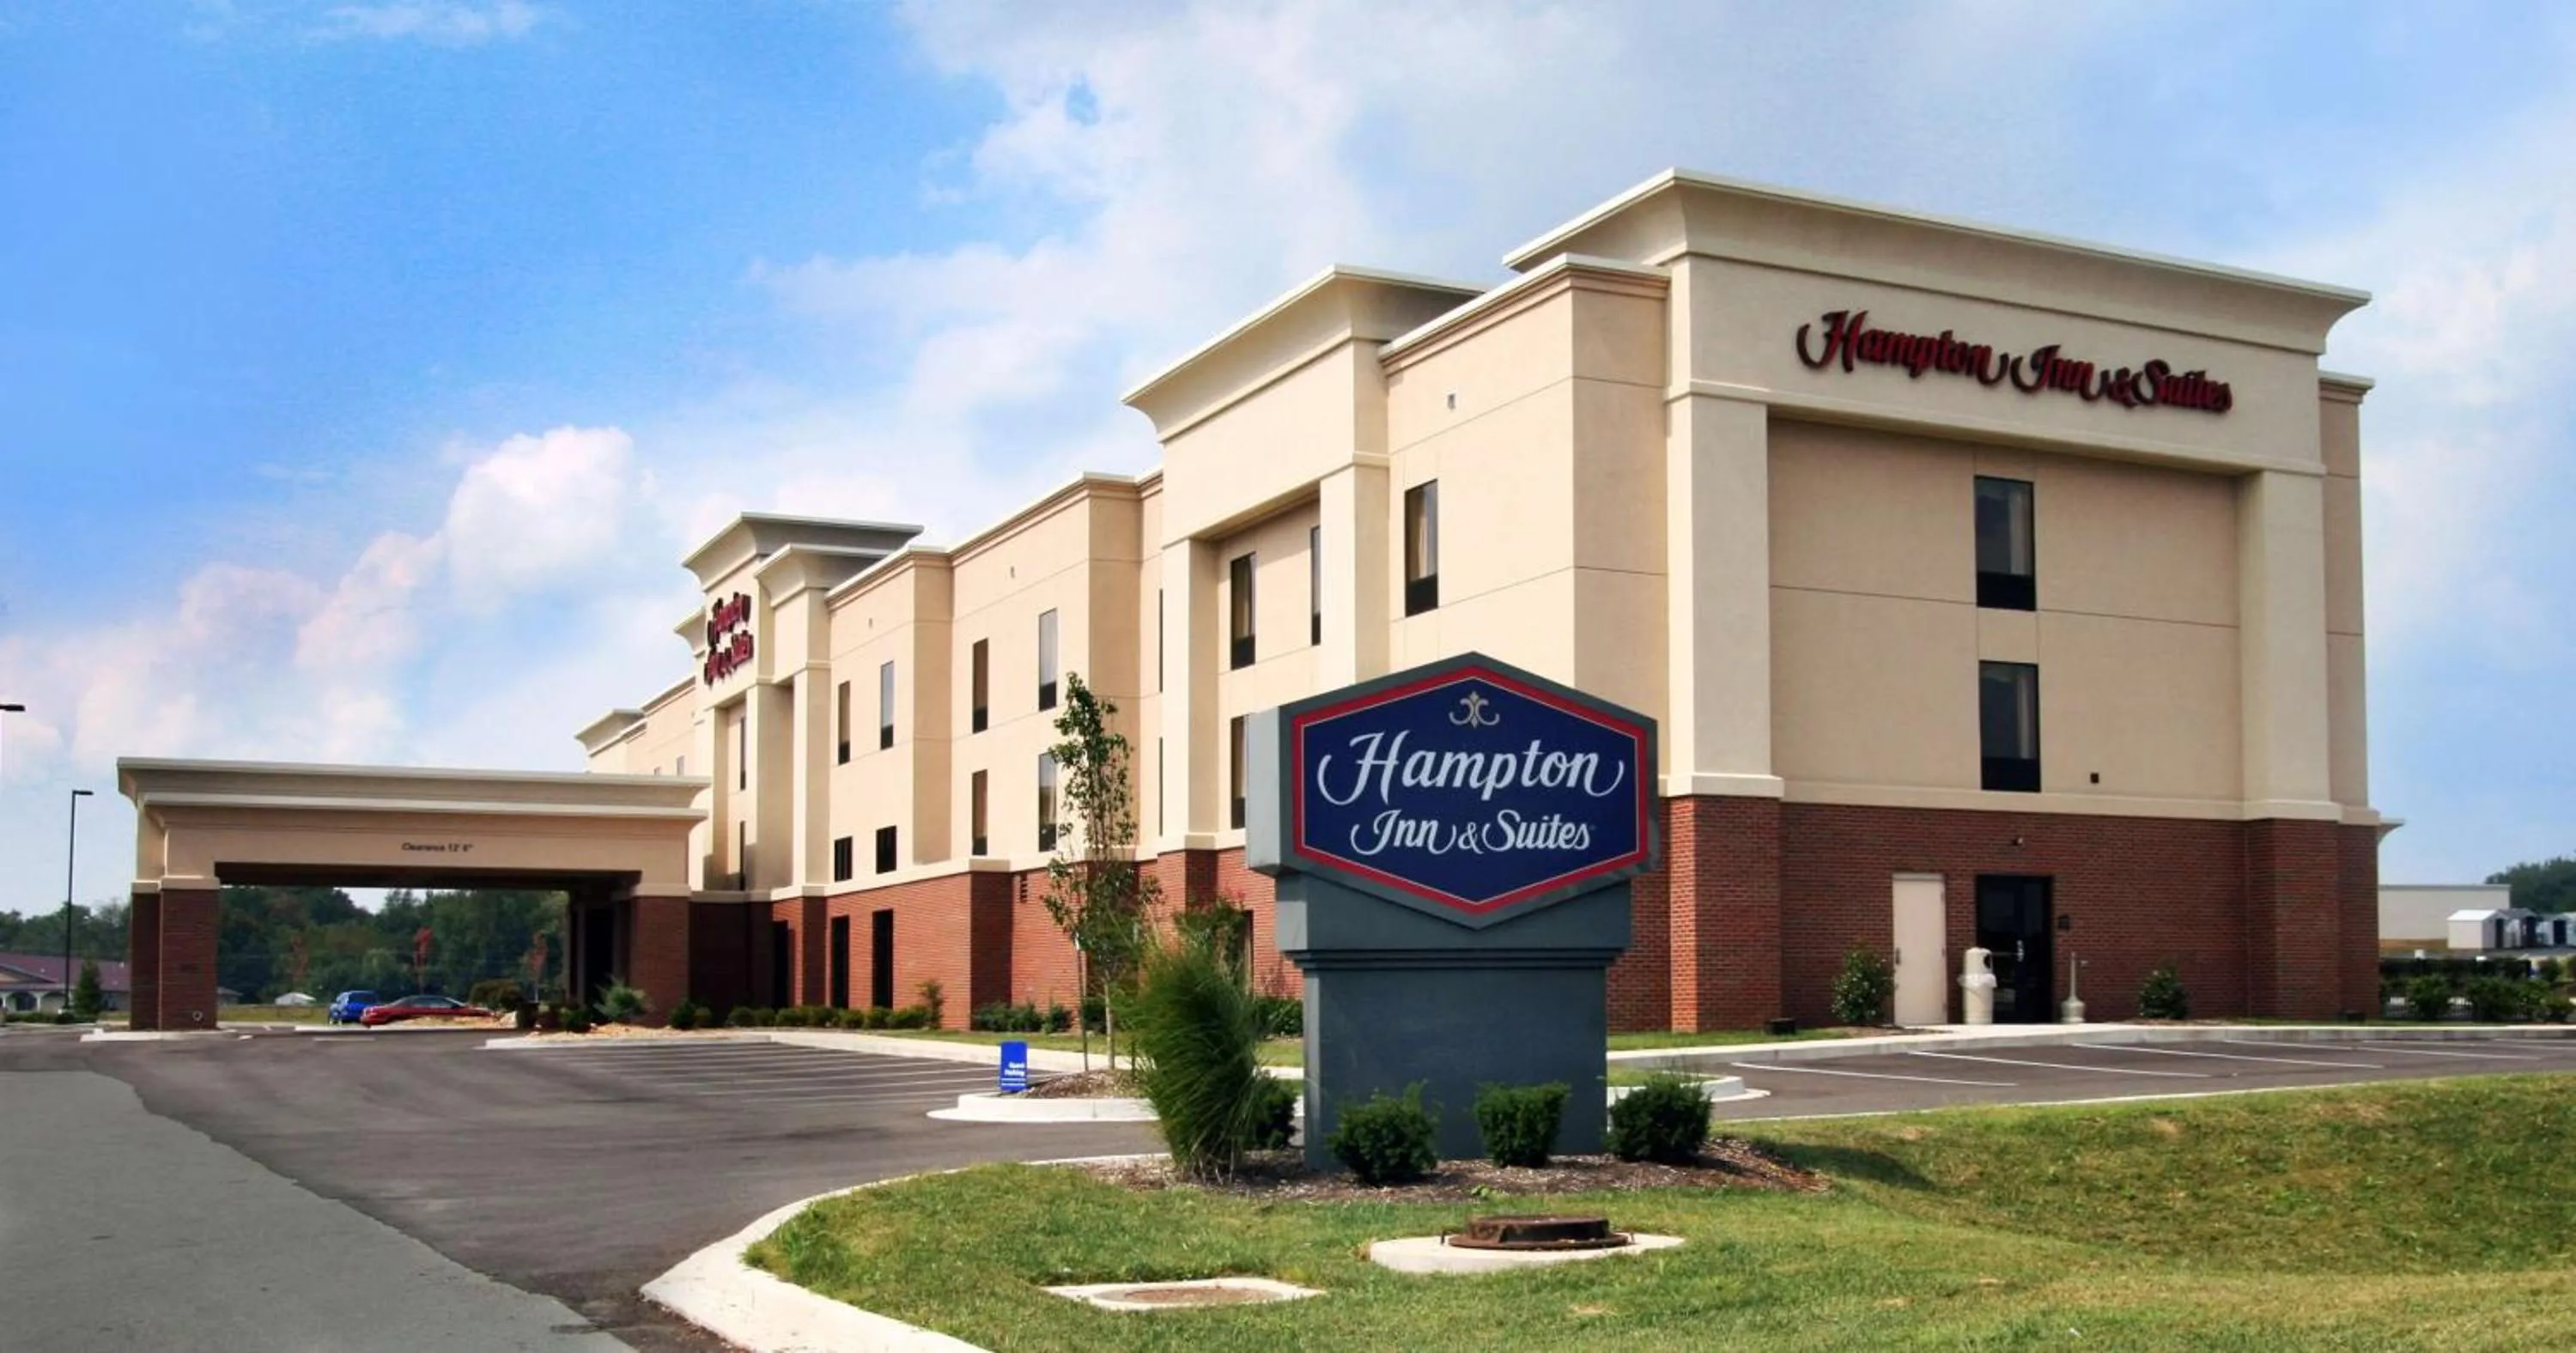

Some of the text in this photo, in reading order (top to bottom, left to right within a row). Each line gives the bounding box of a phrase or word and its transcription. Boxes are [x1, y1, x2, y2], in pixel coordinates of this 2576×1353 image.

[1796, 309, 2233, 413] Hampton Inn & Suites
[1317, 730, 1624, 805] Hampton
[1351, 809, 1591, 856] Inn & Suites
